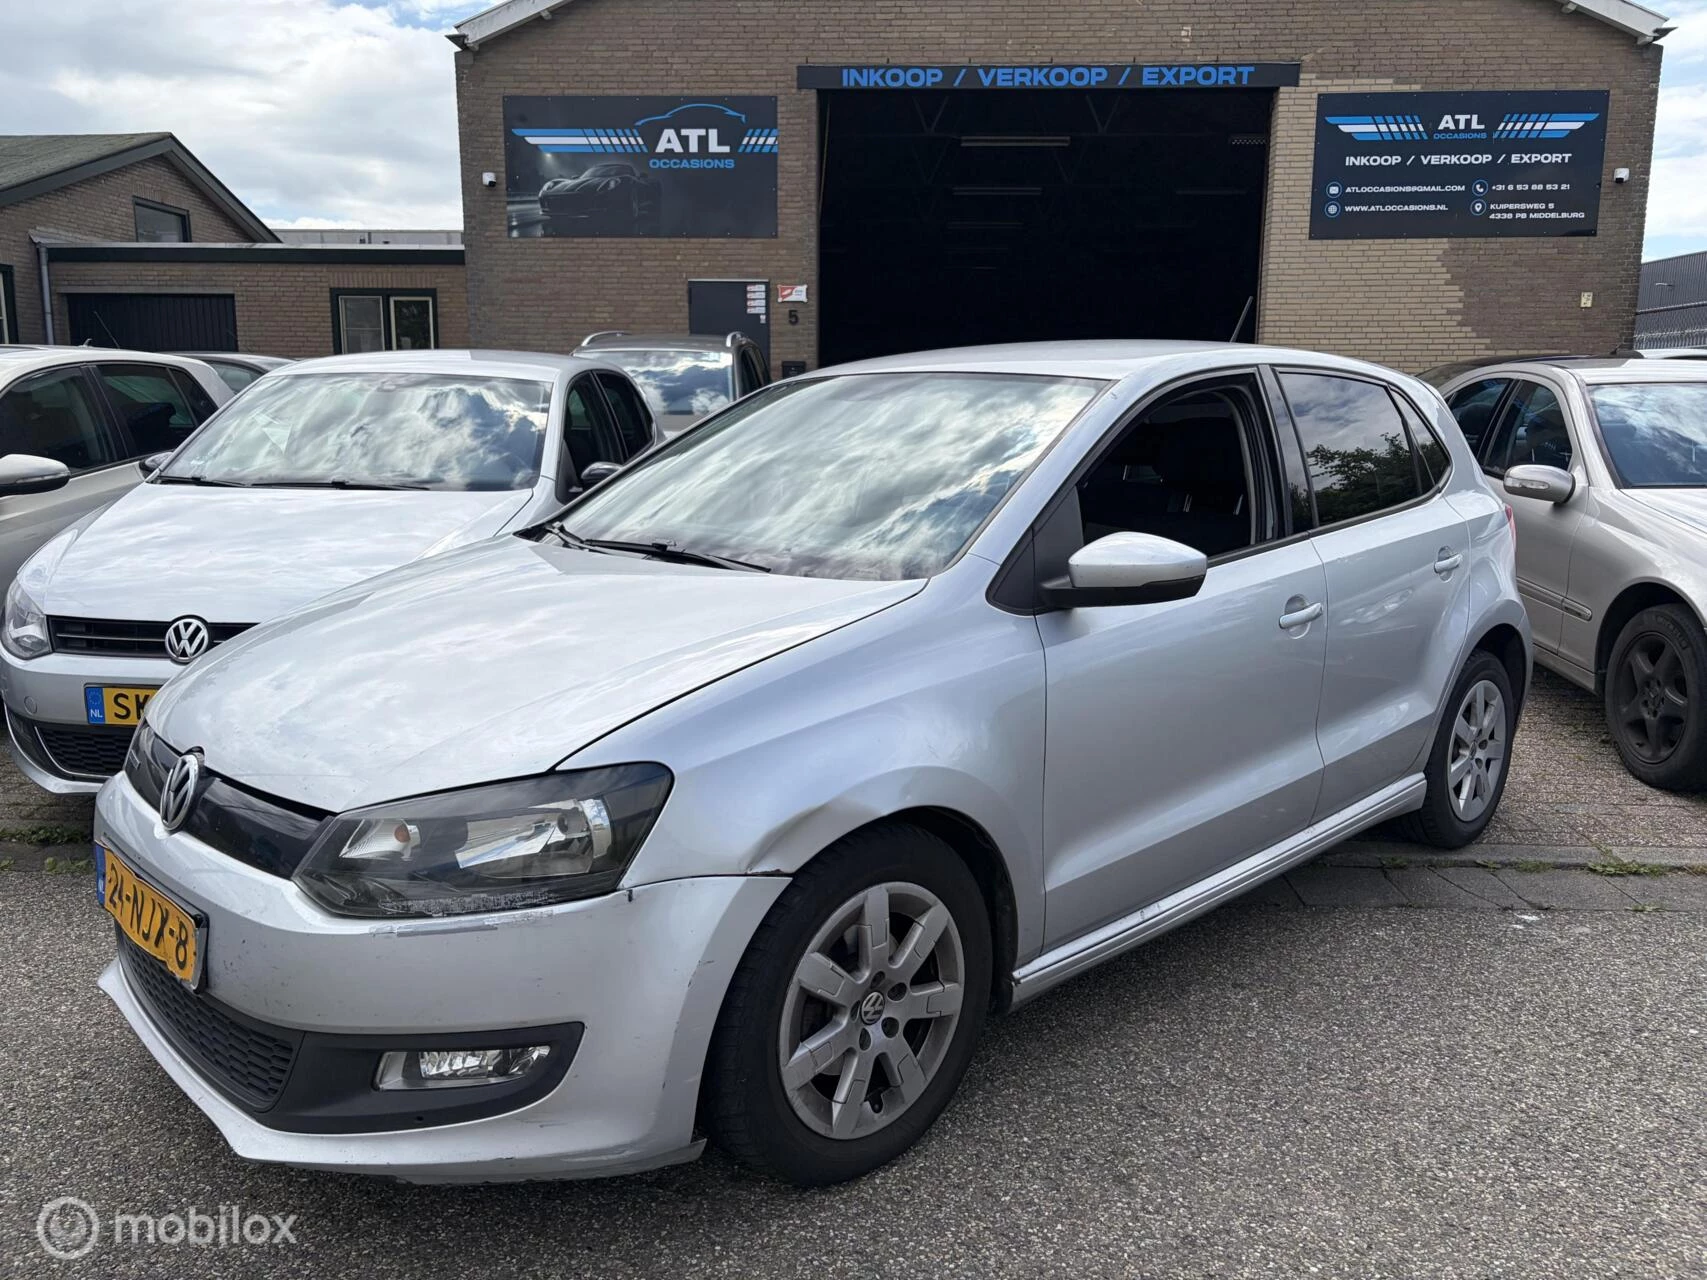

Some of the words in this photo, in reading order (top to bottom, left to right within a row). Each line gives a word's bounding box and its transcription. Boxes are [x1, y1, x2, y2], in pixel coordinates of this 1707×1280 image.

[842, 68, 942, 87] INKOOP
[953, 68, 966, 86] /
[978, 67, 1108, 86] VERKOOP
[1118, 67, 1131, 85] /
[1142, 66, 1255, 86] EXPORT
[1438, 115, 1485, 130] ATL
[655, 128, 731, 153] ATL
[1433, 132, 1487, 140] OCCASIONS
[649, 159, 735, 169] OCCASIONS
[1345, 155, 1402, 167] INKOOP
[1421, 154, 1493, 165] VERKOOP
[1511, 153, 1572, 164] EXPORT
[1345, 204, 1448, 212] WWW.ATLOCCASIONS.NL
[788, 310, 799, 325] 5
[90, 708, 103, 718] NL
[109, 862, 189, 970] 24-NJX-8
